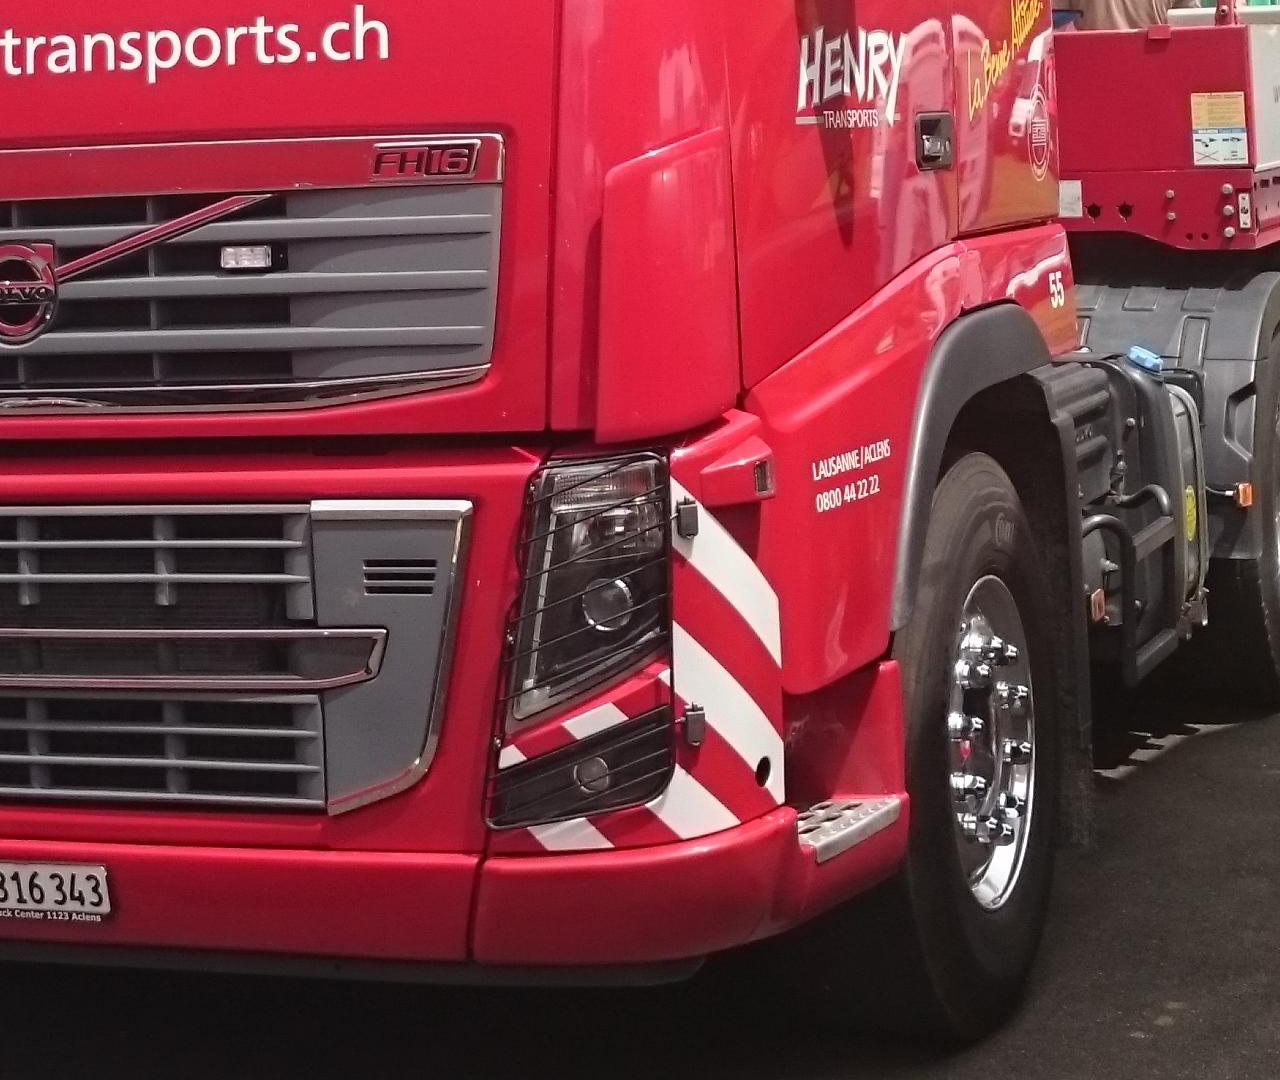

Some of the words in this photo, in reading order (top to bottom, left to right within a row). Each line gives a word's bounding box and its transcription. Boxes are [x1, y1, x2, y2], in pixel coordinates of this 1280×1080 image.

[797, 26, 908, 128] HENRY
[823, 109, 879, 129] TRANSPORTS
[1048, 271, 1065, 309] 55
[816, 487, 842, 512] 0800
[843, 482, 856, 502] 44
[856, 478, 869, 499] 22
[869, 474, 880, 494] 22
[48, 873, 104, 907] 343
[15, 909, 45, 920] Center
[46, 911, 70, 921] 1123
[72, 912, 102, 923] Aclens
